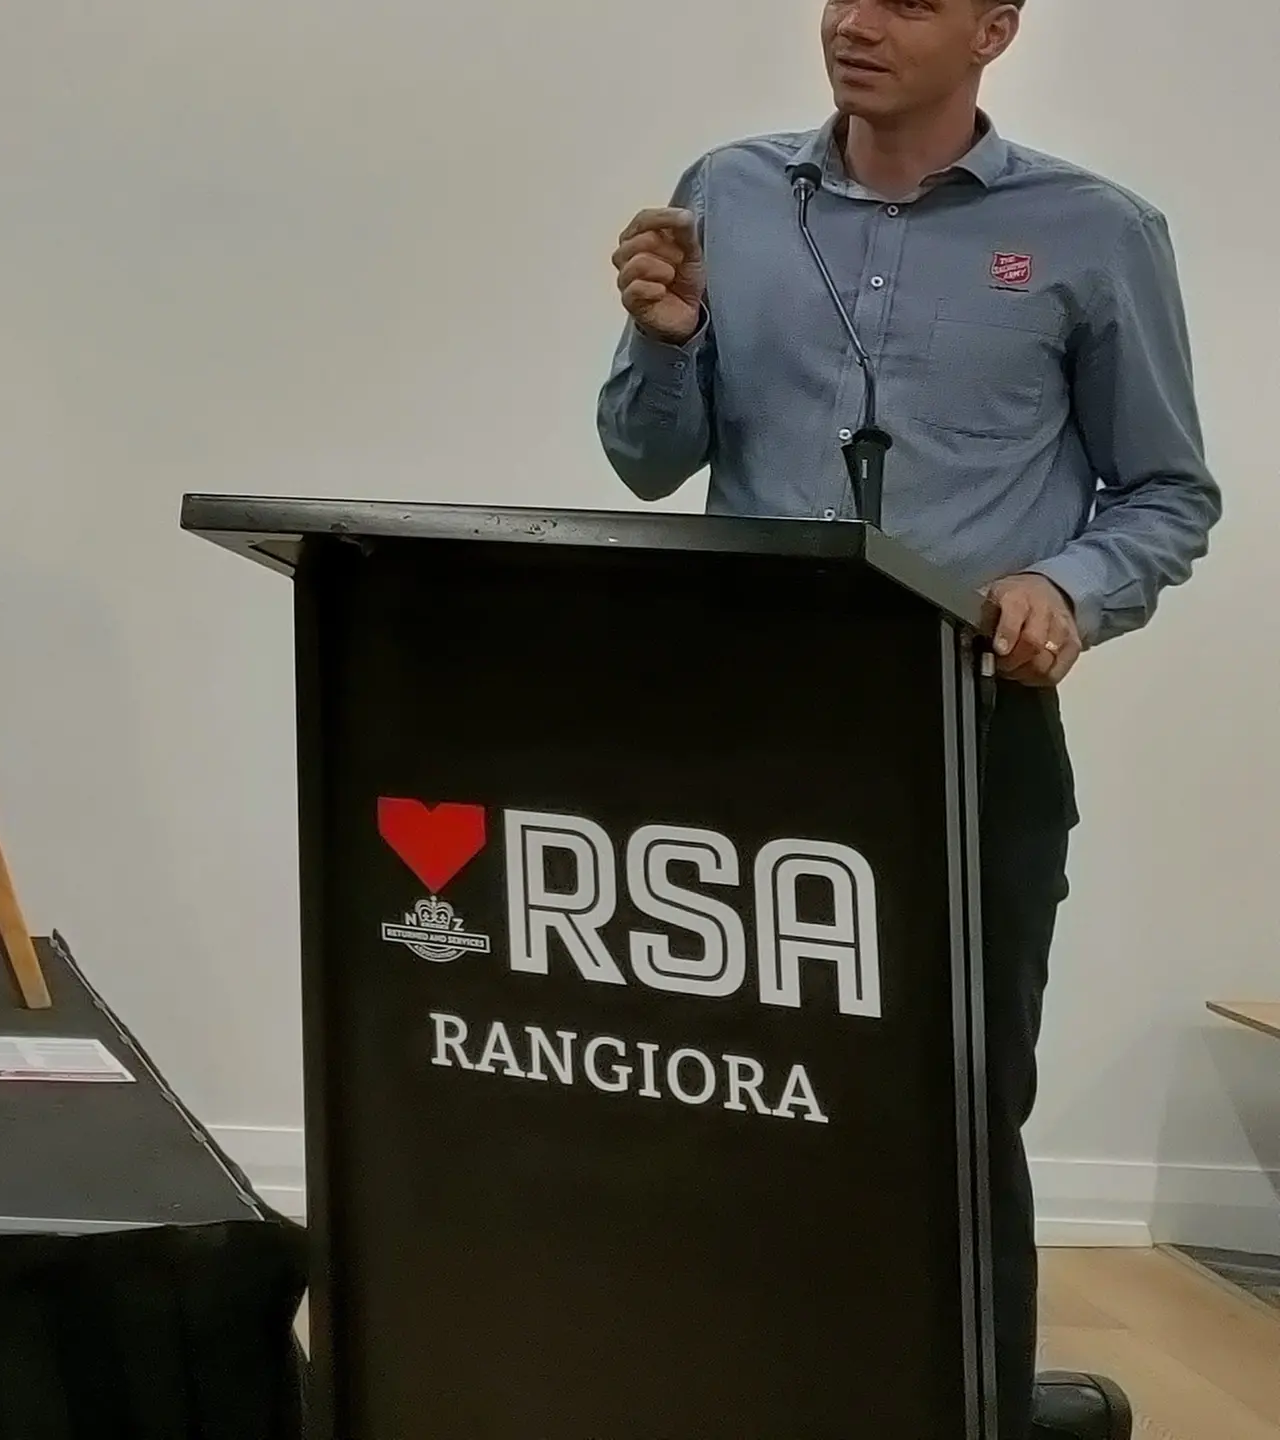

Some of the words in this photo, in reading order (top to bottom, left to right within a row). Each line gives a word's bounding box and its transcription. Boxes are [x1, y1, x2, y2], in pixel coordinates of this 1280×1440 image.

[405, 913, 417, 925] N
[452, 918, 464, 931] Z
[503, 808, 882, 1018] RSA
[429, 1012, 829, 1124] RANGIORA
